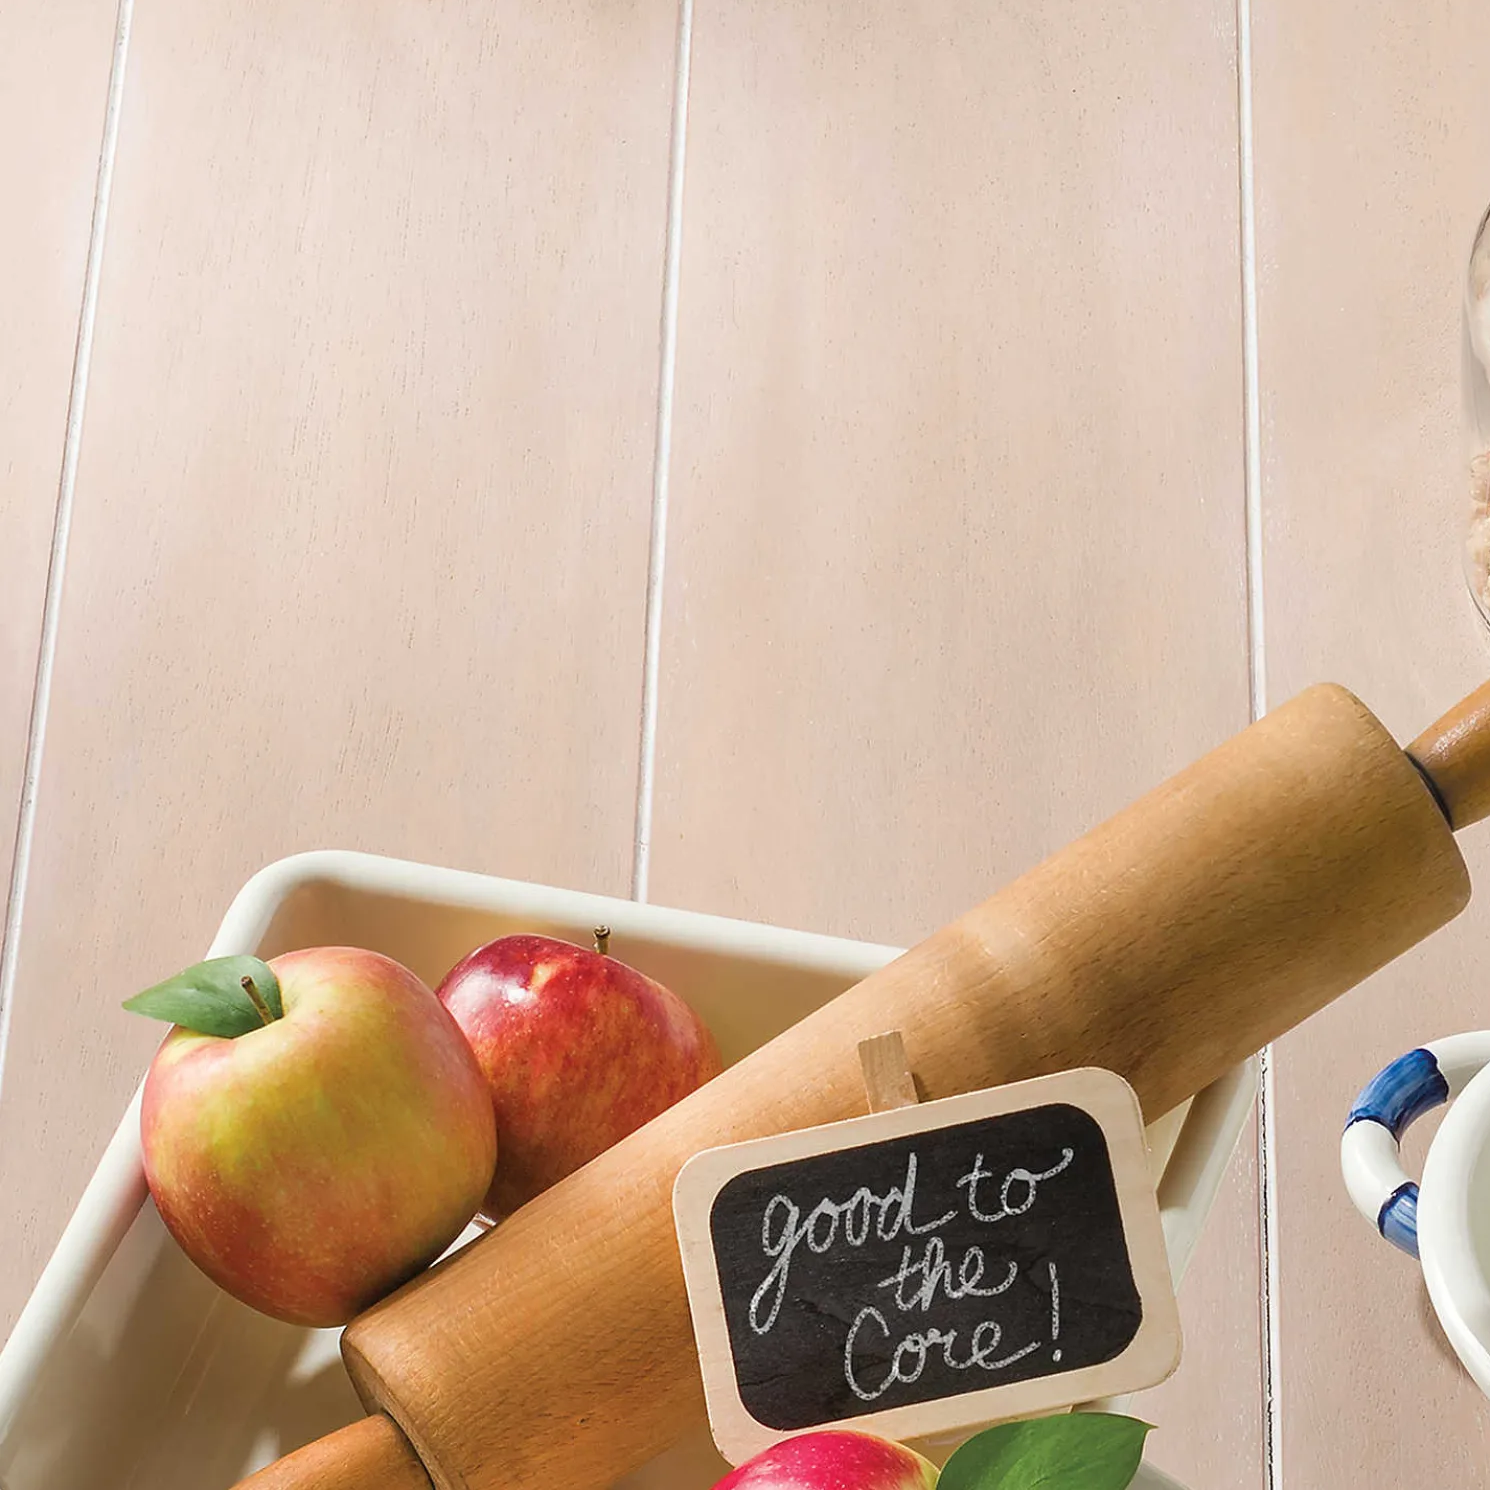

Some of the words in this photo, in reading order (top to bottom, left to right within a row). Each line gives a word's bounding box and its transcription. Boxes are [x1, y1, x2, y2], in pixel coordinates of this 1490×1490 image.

[748, 1150, 959, 1334] good
[956, 1147, 1074, 1223] to
[876, 1236, 1019, 1312] the
[843, 1262, 1064, 1401] Core!
